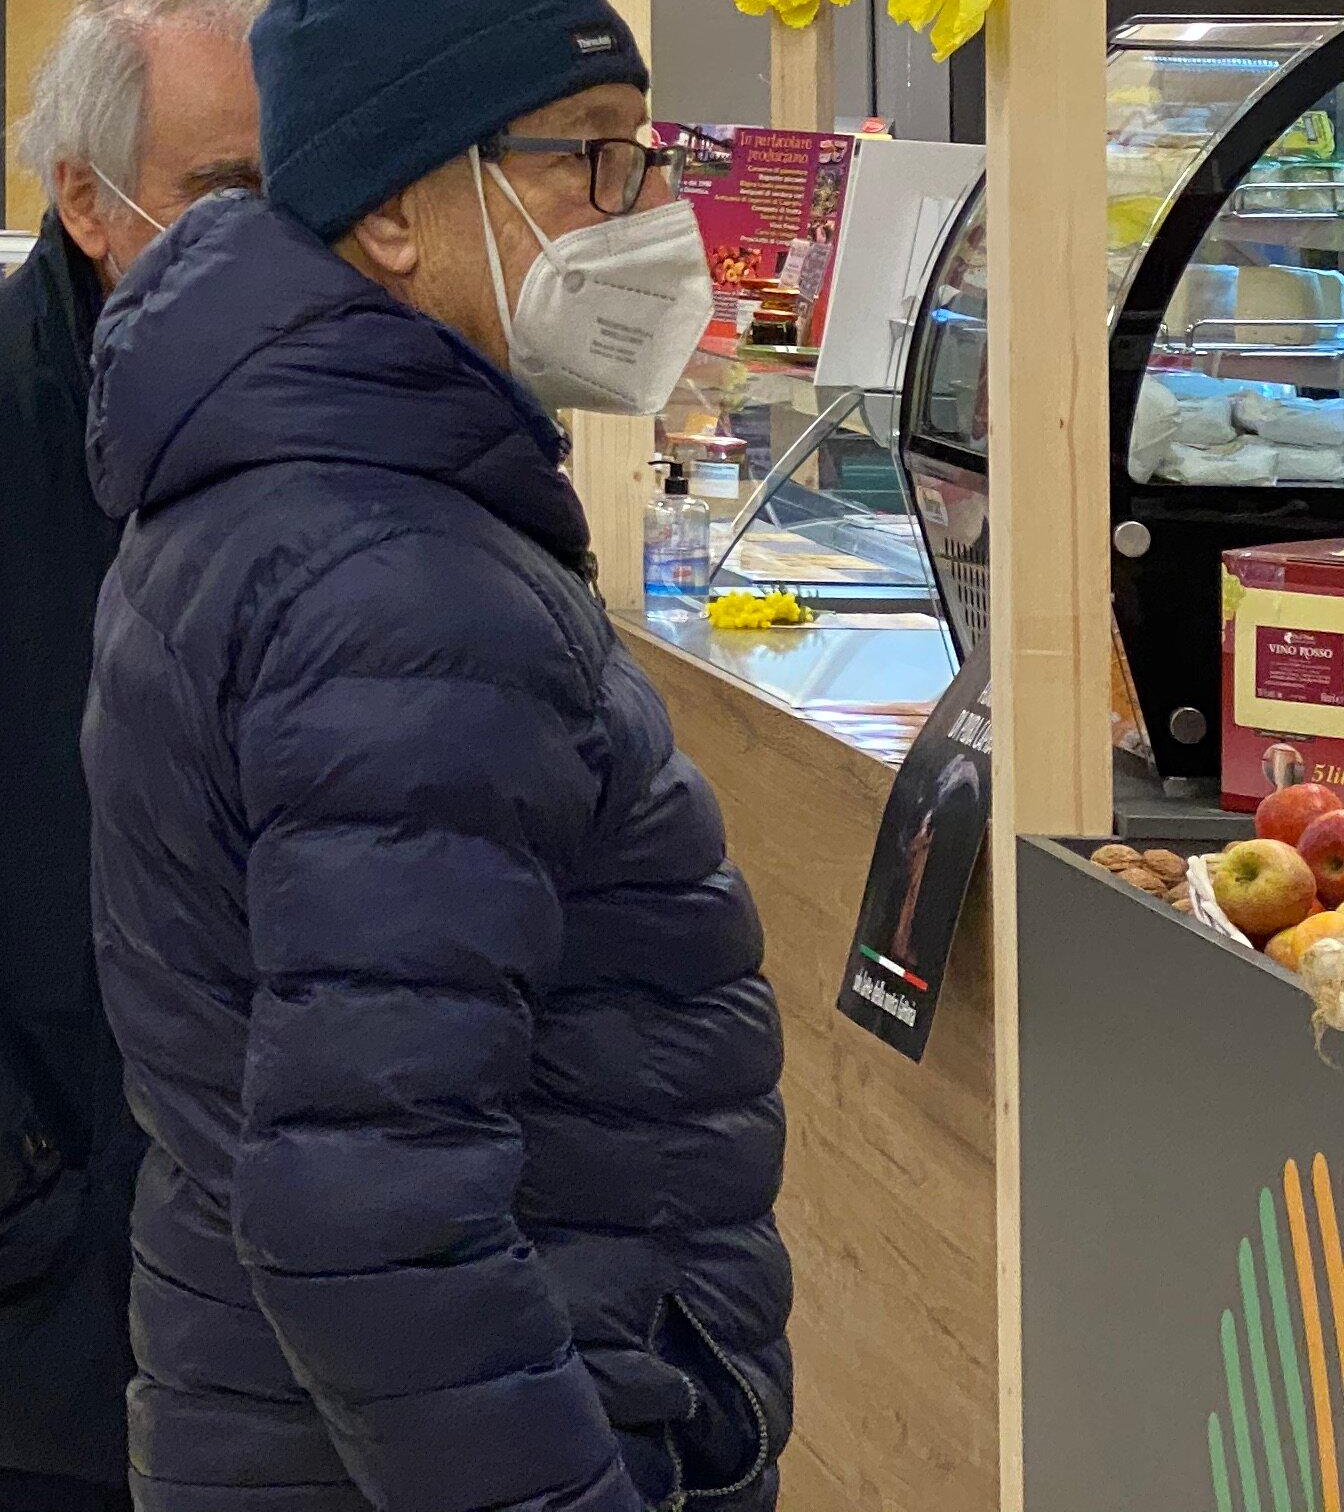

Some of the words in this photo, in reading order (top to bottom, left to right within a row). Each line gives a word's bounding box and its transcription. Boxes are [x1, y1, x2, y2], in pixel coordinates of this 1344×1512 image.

[1268, 643, 1297, 656] VINO
[1300, 645, 1334, 661] ROSSO
[1312, 763, 1326, 783] 5
